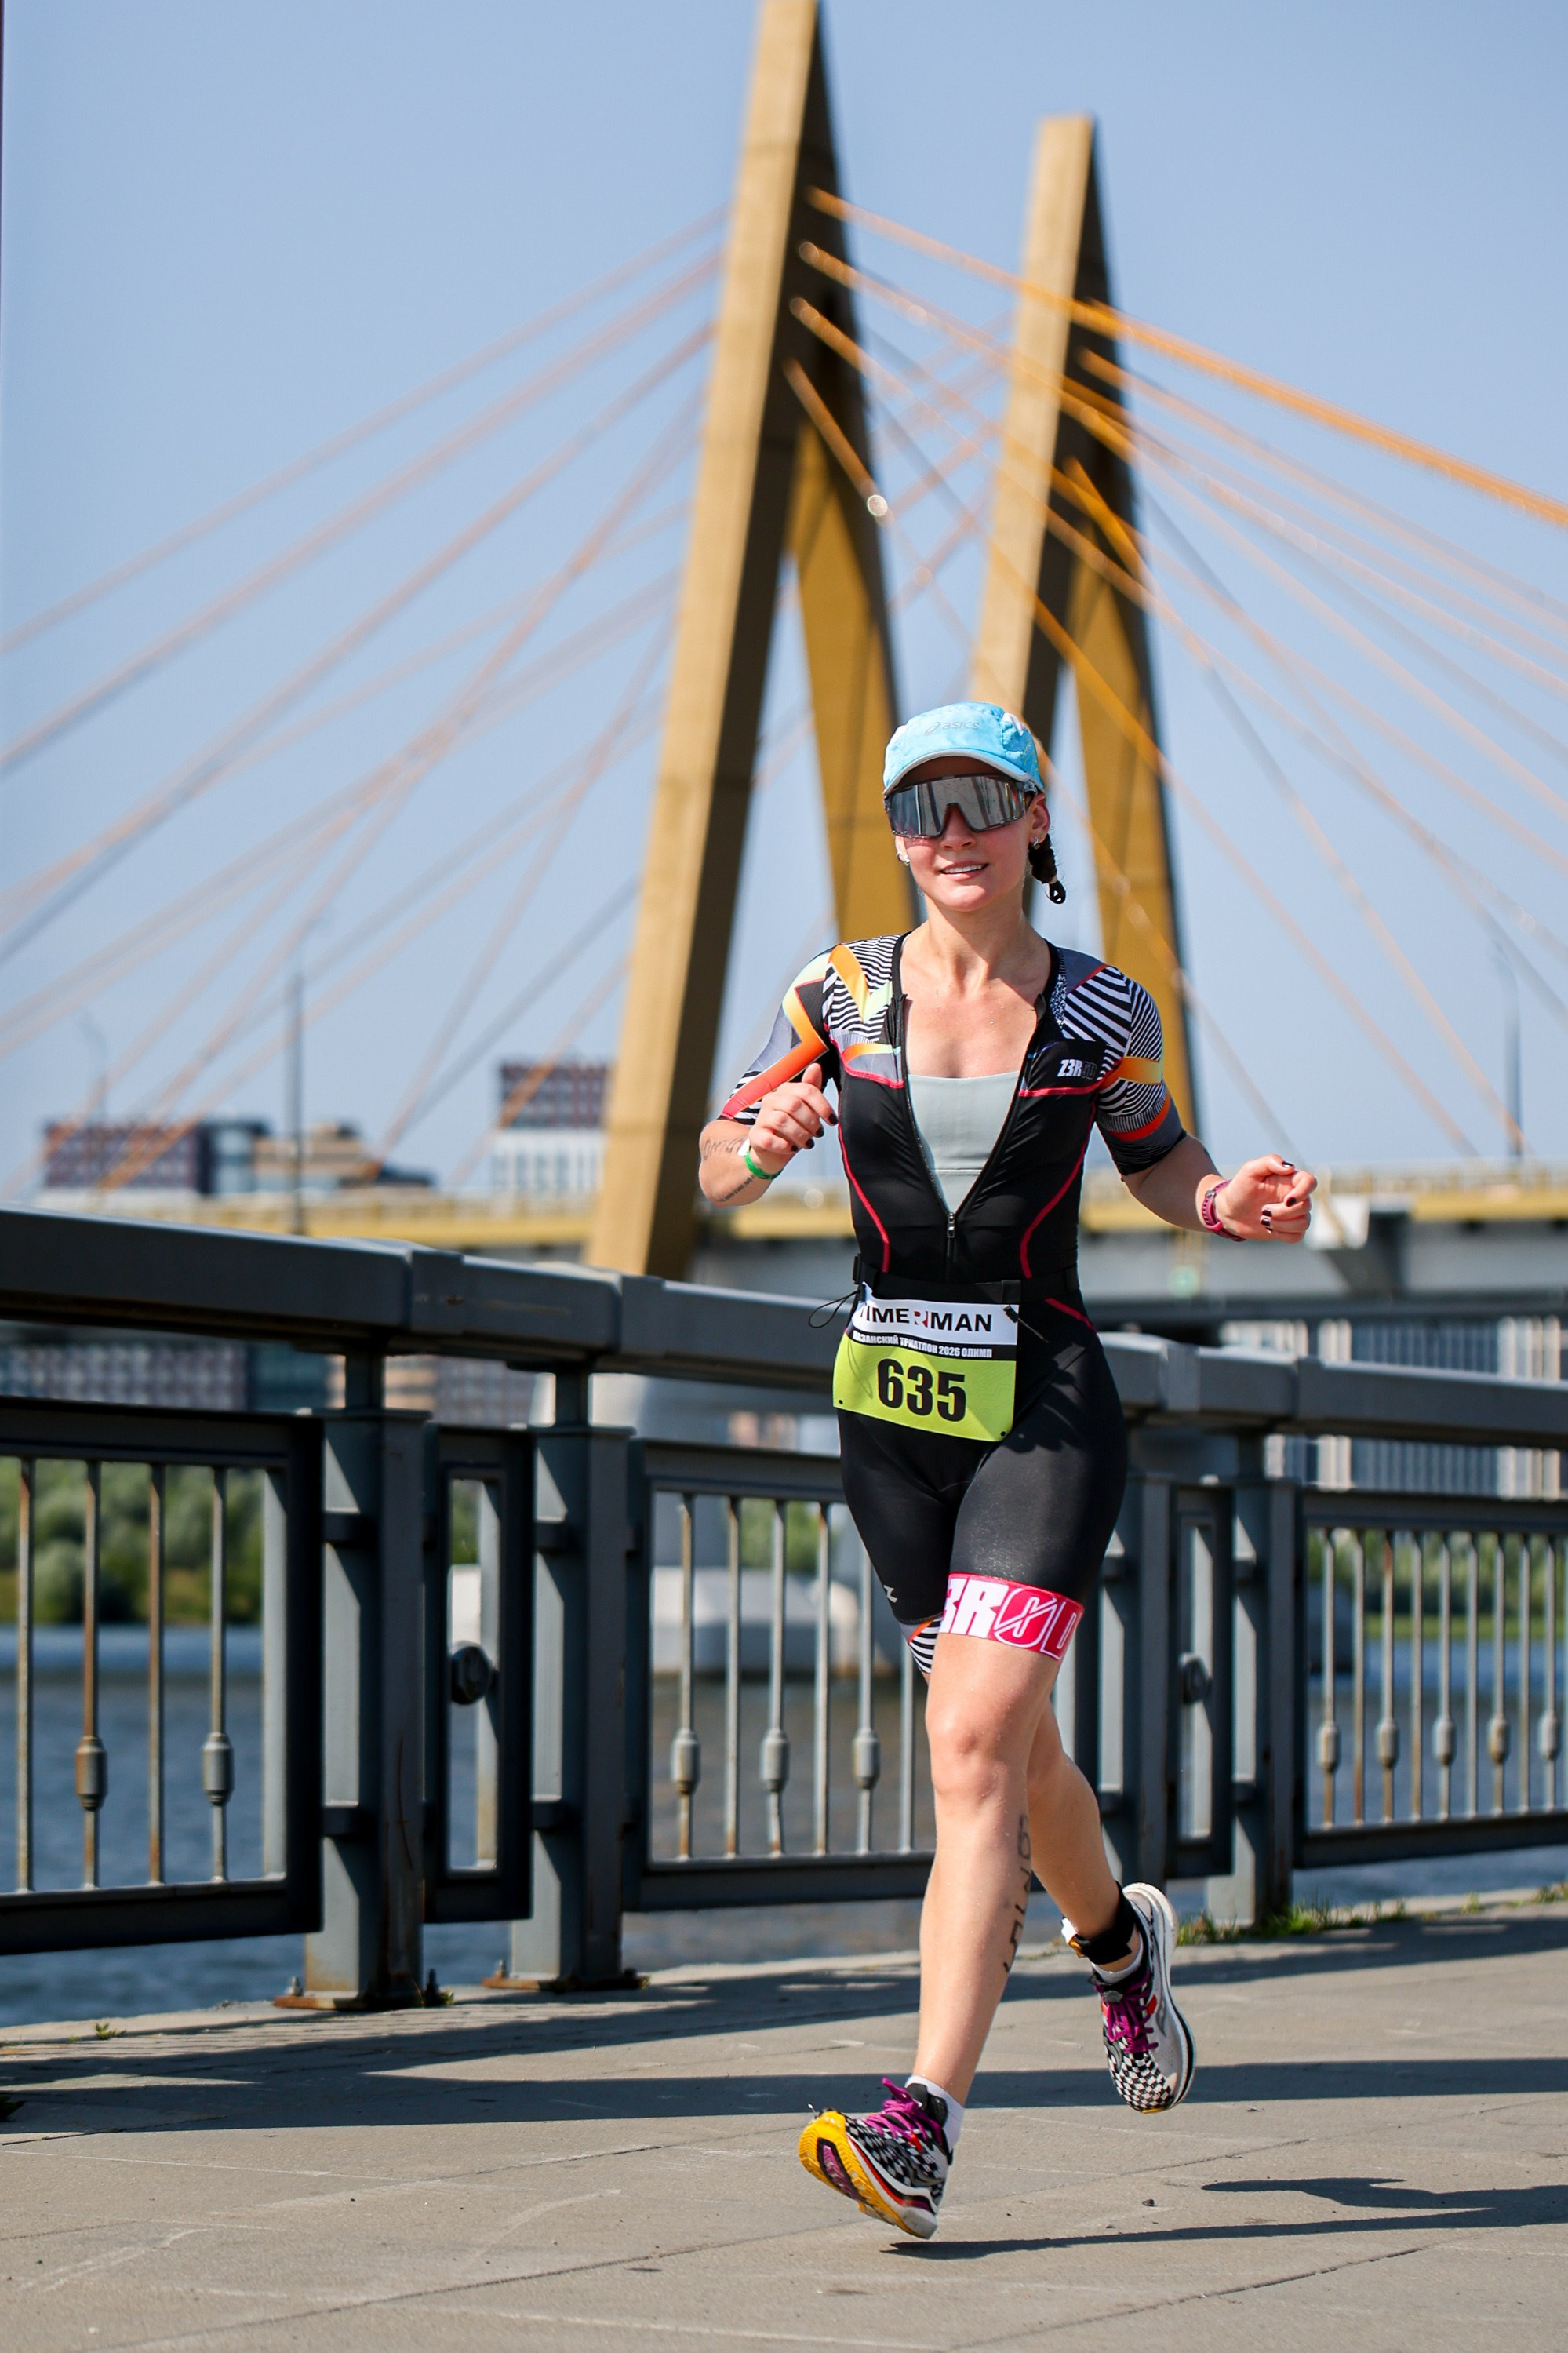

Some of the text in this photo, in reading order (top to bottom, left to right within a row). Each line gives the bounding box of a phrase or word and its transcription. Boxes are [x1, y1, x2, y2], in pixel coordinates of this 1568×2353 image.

[942, 721, 980, 730] asics
[899, 1337, 938, 1354] ТРИАТЛОН
[938, 1346, 961, 1357] 2026
[961, 1348, 993, 1358] ОЛИМП
[877, 1358, 966, 1422] 635
